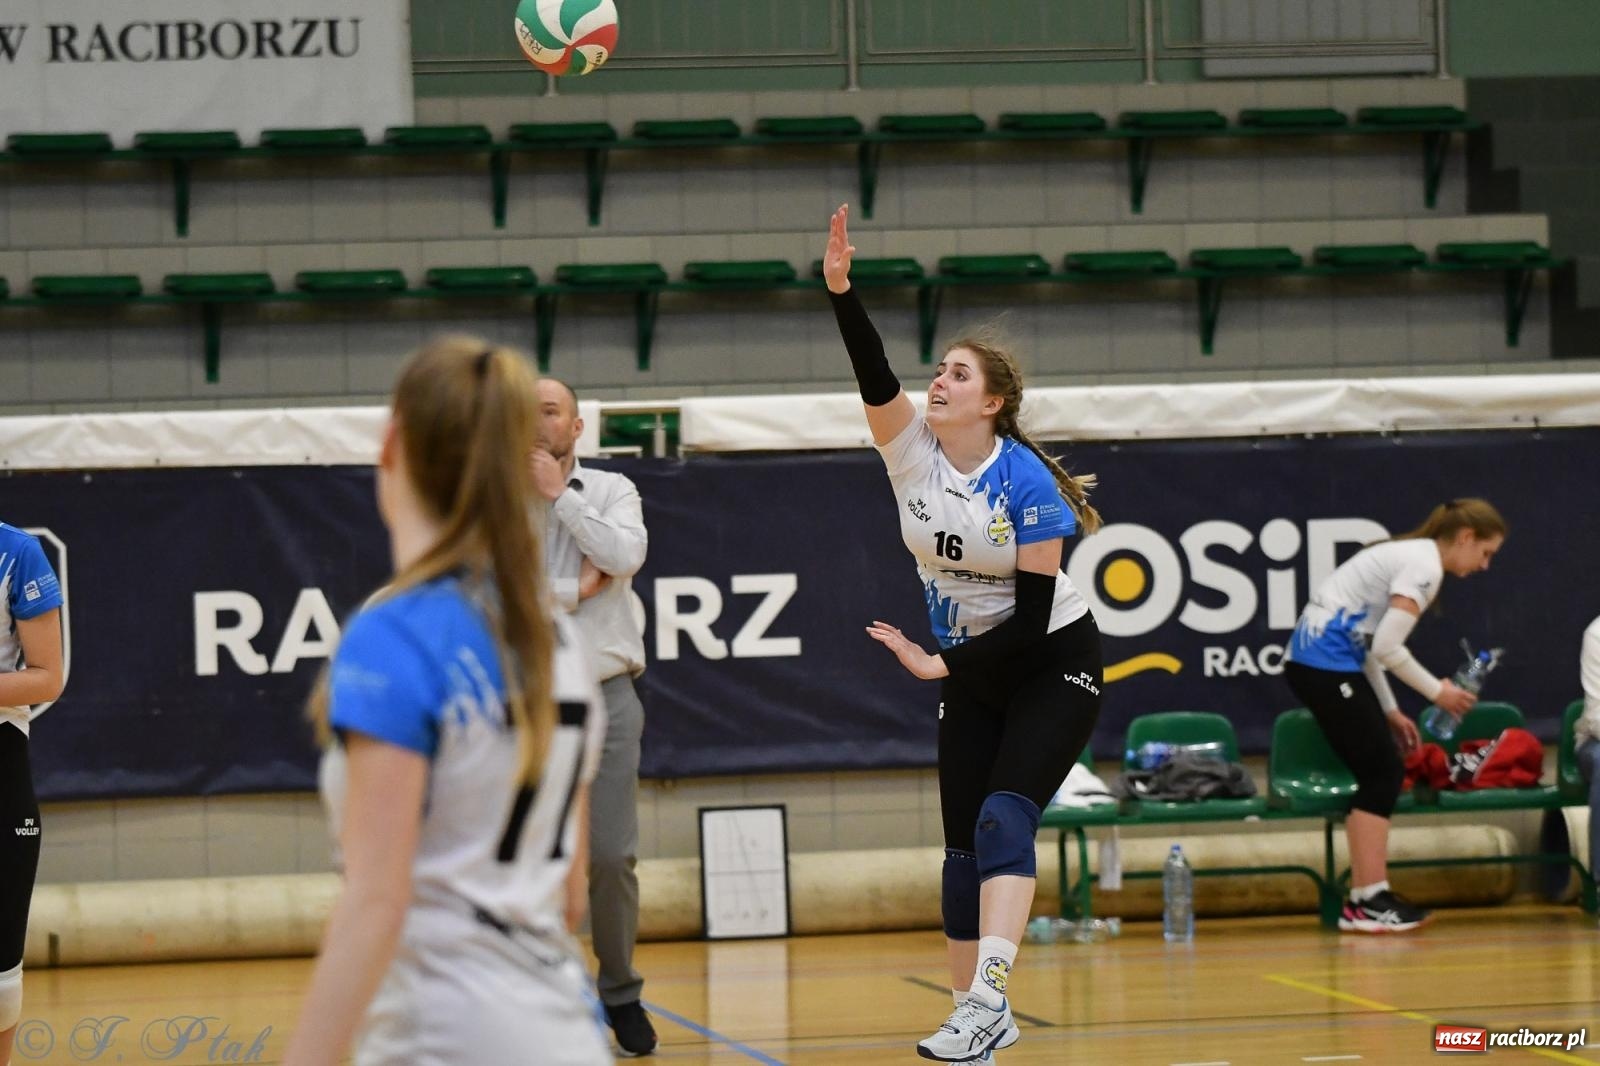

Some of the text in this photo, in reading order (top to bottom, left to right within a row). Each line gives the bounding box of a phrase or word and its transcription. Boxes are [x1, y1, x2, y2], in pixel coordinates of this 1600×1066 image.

[47, 18, 363, 63] RACIBORZU
[908, 499, 931, 522] VOLLEY
[934, 530, 963, 562] 16
[1064, 673, 1100, 696] VOLLEY
[15, 827, 40, 836] VOLLEY
